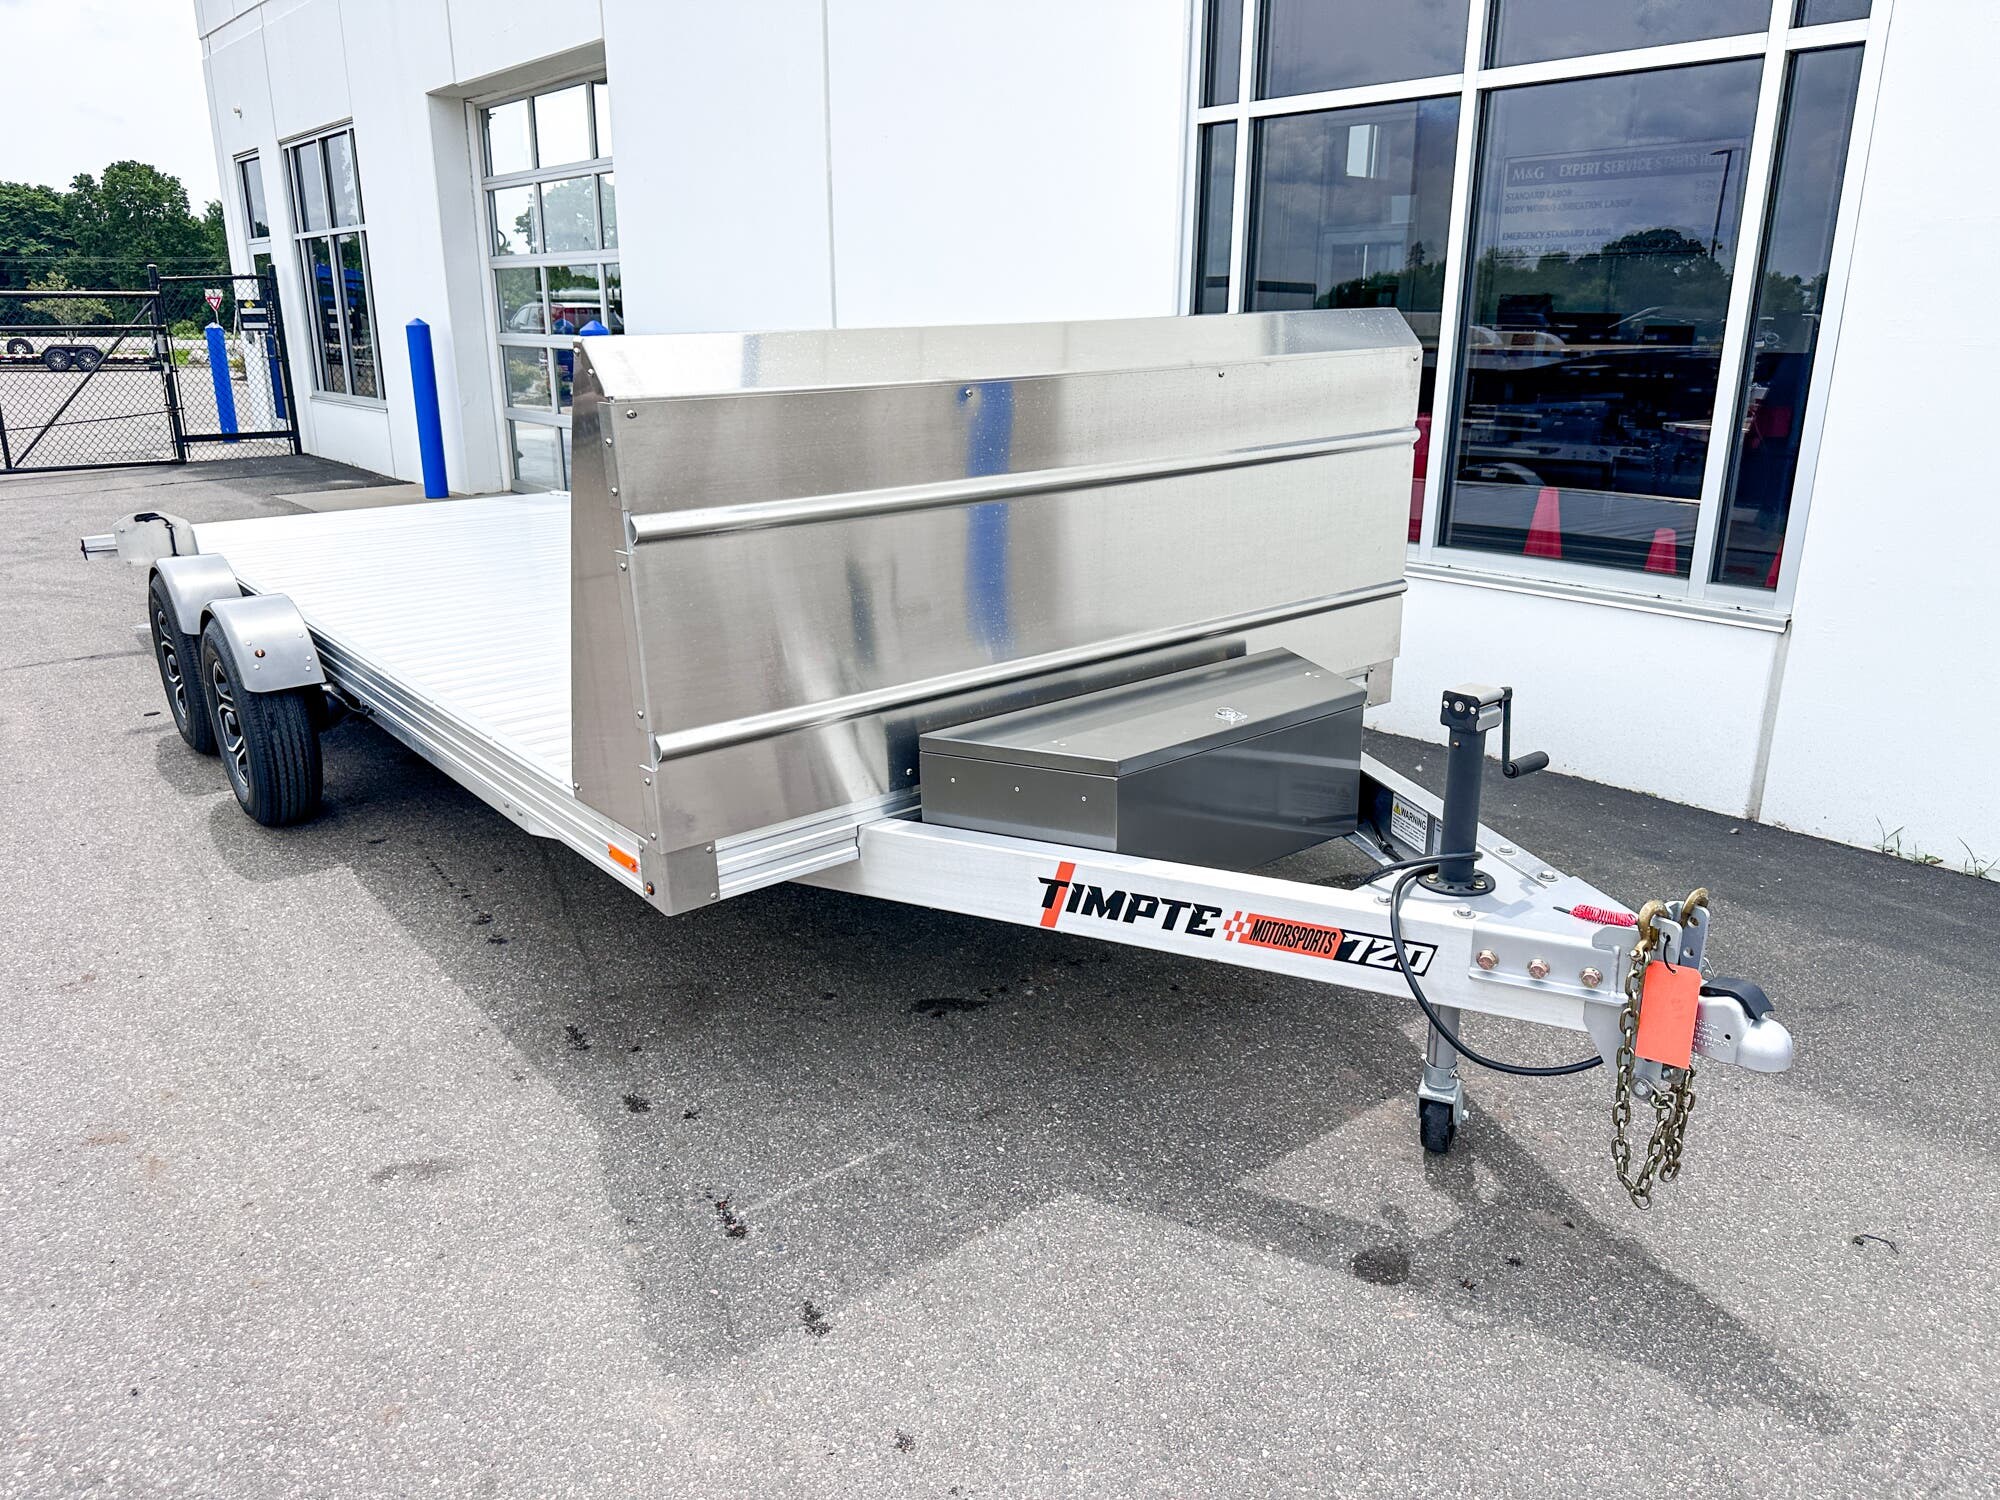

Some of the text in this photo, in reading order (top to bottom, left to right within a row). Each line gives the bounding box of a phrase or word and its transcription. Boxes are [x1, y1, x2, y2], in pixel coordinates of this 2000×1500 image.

[1512, 166, 1545, 181] M&G
[1560, 161, 1601, 177] EXPERT
[1603, 157, 1653, 174] SERVICE
[1505, 190, 1545, 201] STANDARD
[1401, 807, 1427, 830] WARNING
[1037, 874, 1223, 938] TIMPTE
[1248, 919, 1338, 955] MOTORSPORTS
